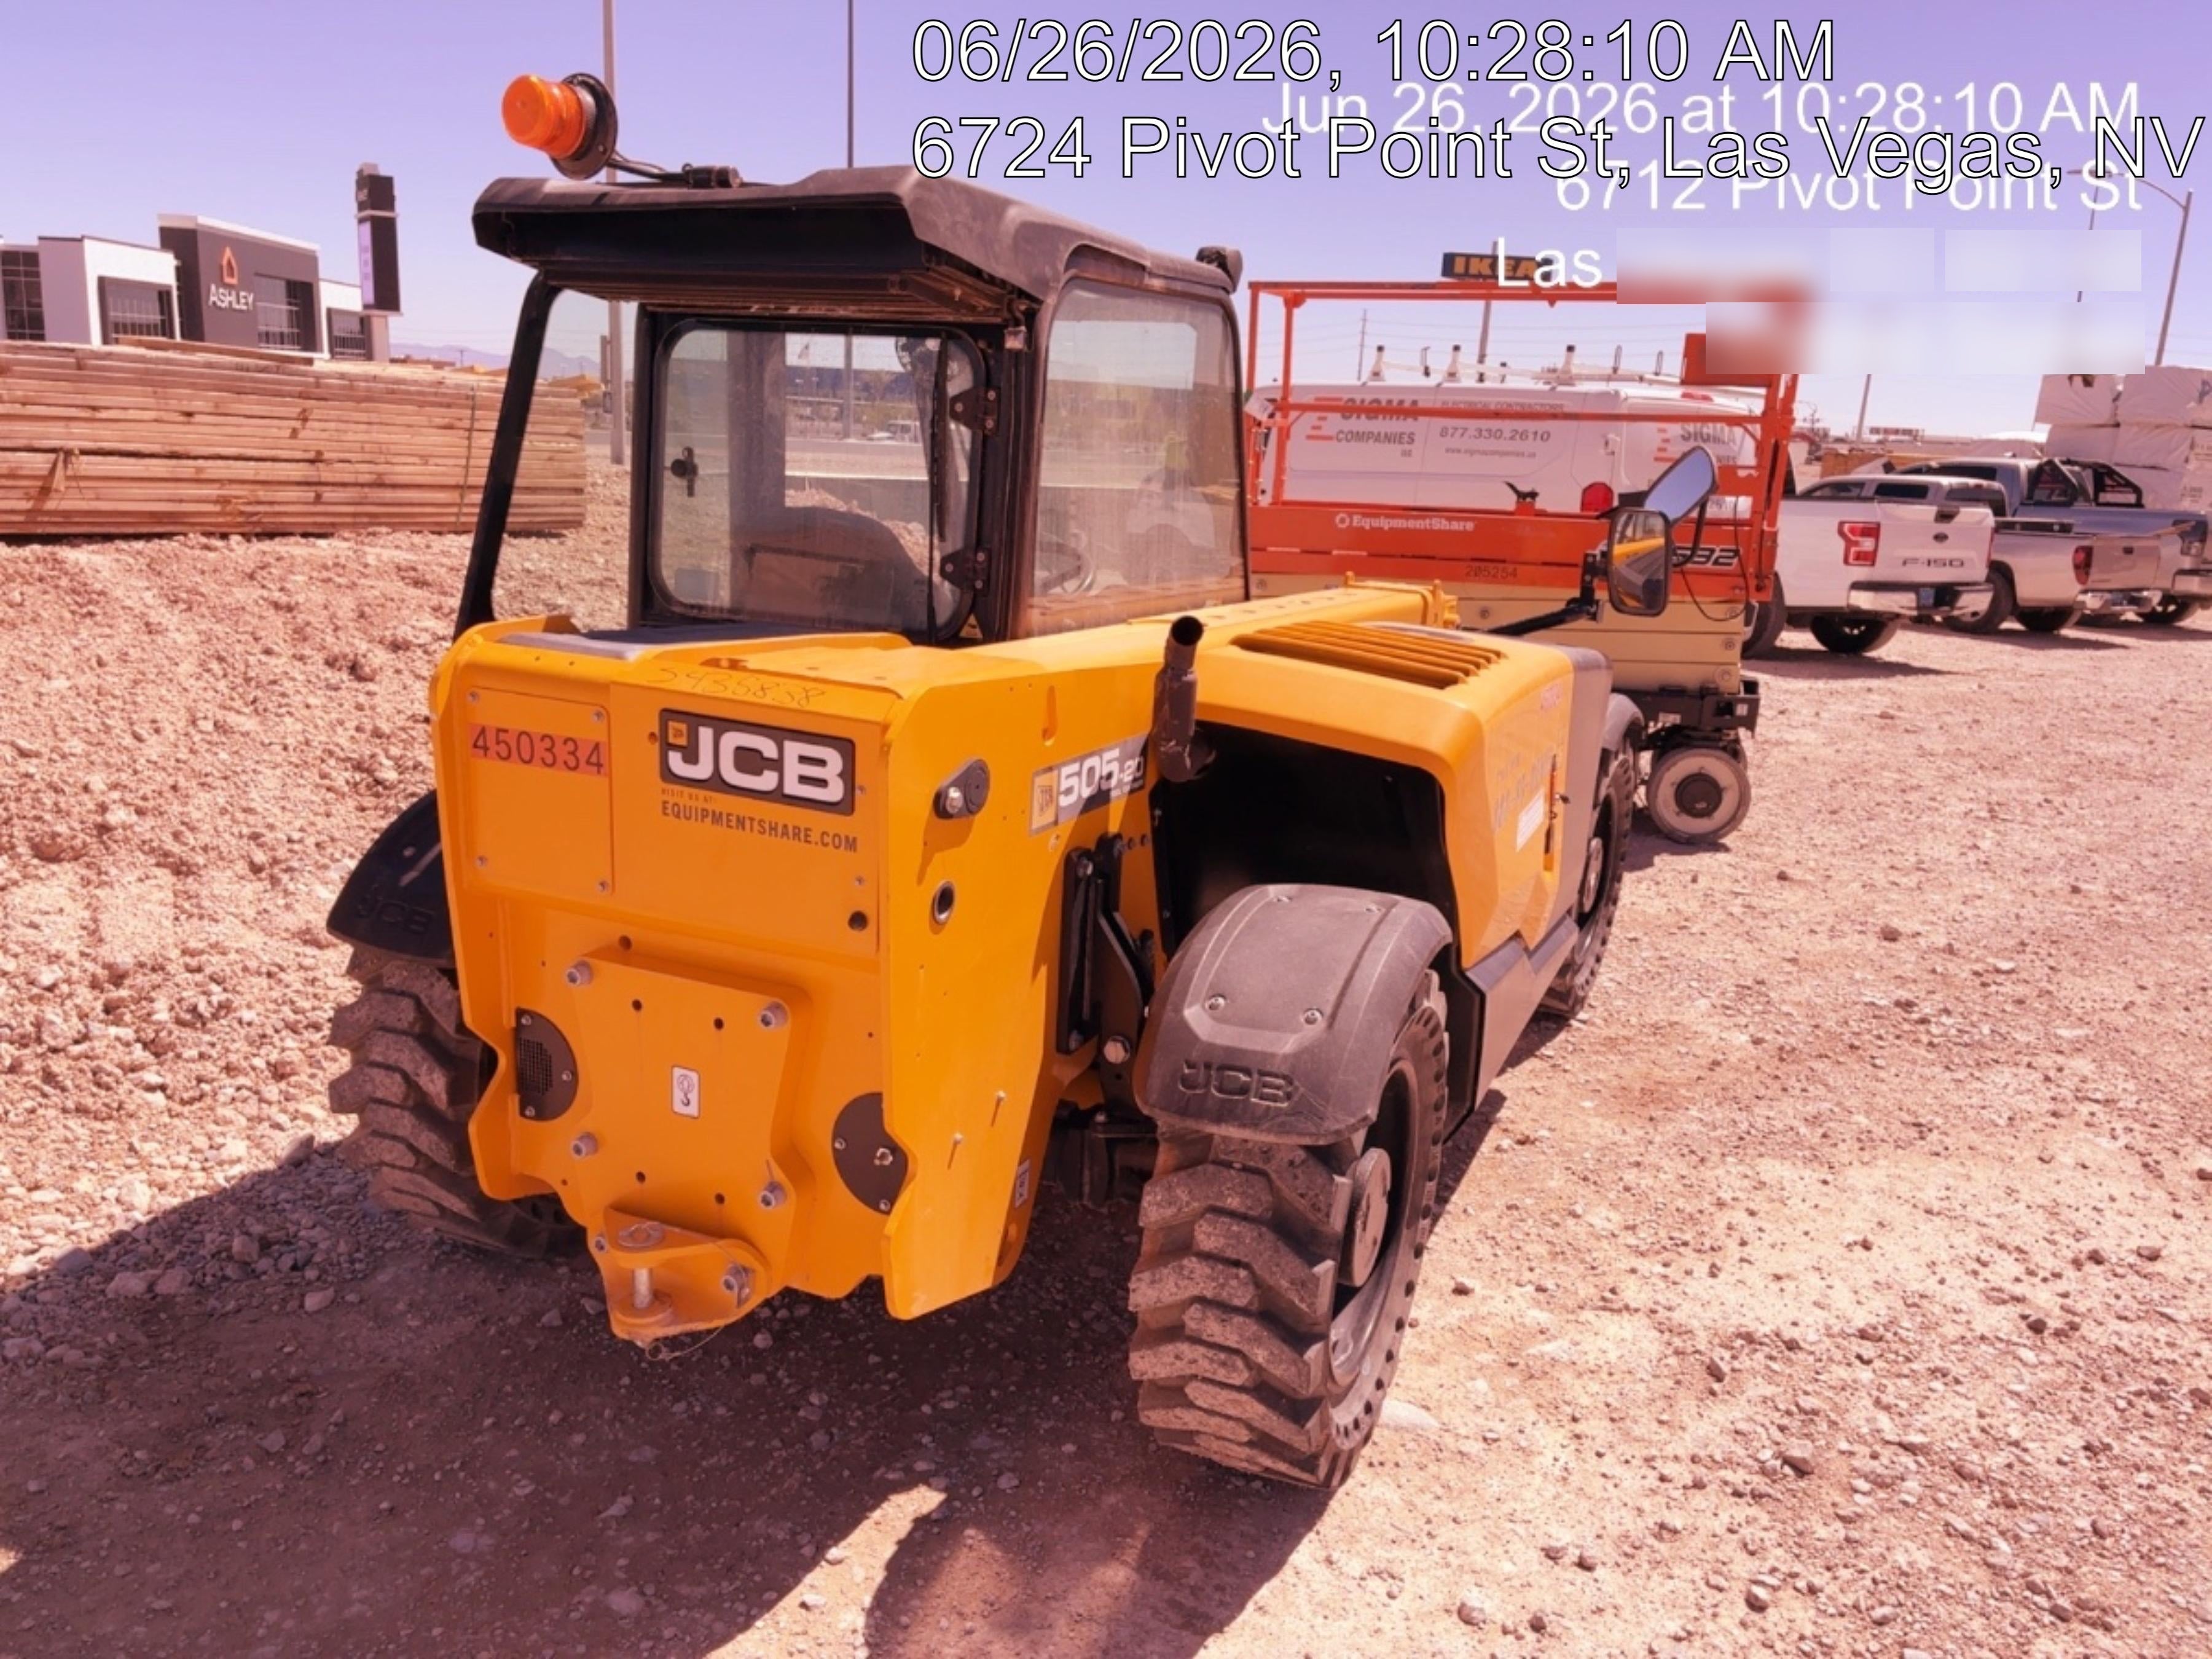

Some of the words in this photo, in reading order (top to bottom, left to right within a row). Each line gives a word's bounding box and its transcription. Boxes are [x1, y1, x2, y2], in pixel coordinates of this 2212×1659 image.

[1454, 256, 1538, 277] IKEA
[208, 283, 254, 310] ASHLEY
[1340, 397, 1419, 422] SIGMA
[1336, 429, 1416, 445] COMPANIES
[1439, 426, 1551, 443] 877.330.2610
[1353, 514, 1475, 531] EquipmentShare
[1465, 565, 1518, 579] 205254
[1902, 558, 1964, 568] F-150
[473, 725, 605, 775] 450334
[667, 725, 845, 804] JCB
[661, 799, 858, 852] EQUIPMENTSHARE.COM
[1179, 1059, 1296, 1107] JCB
